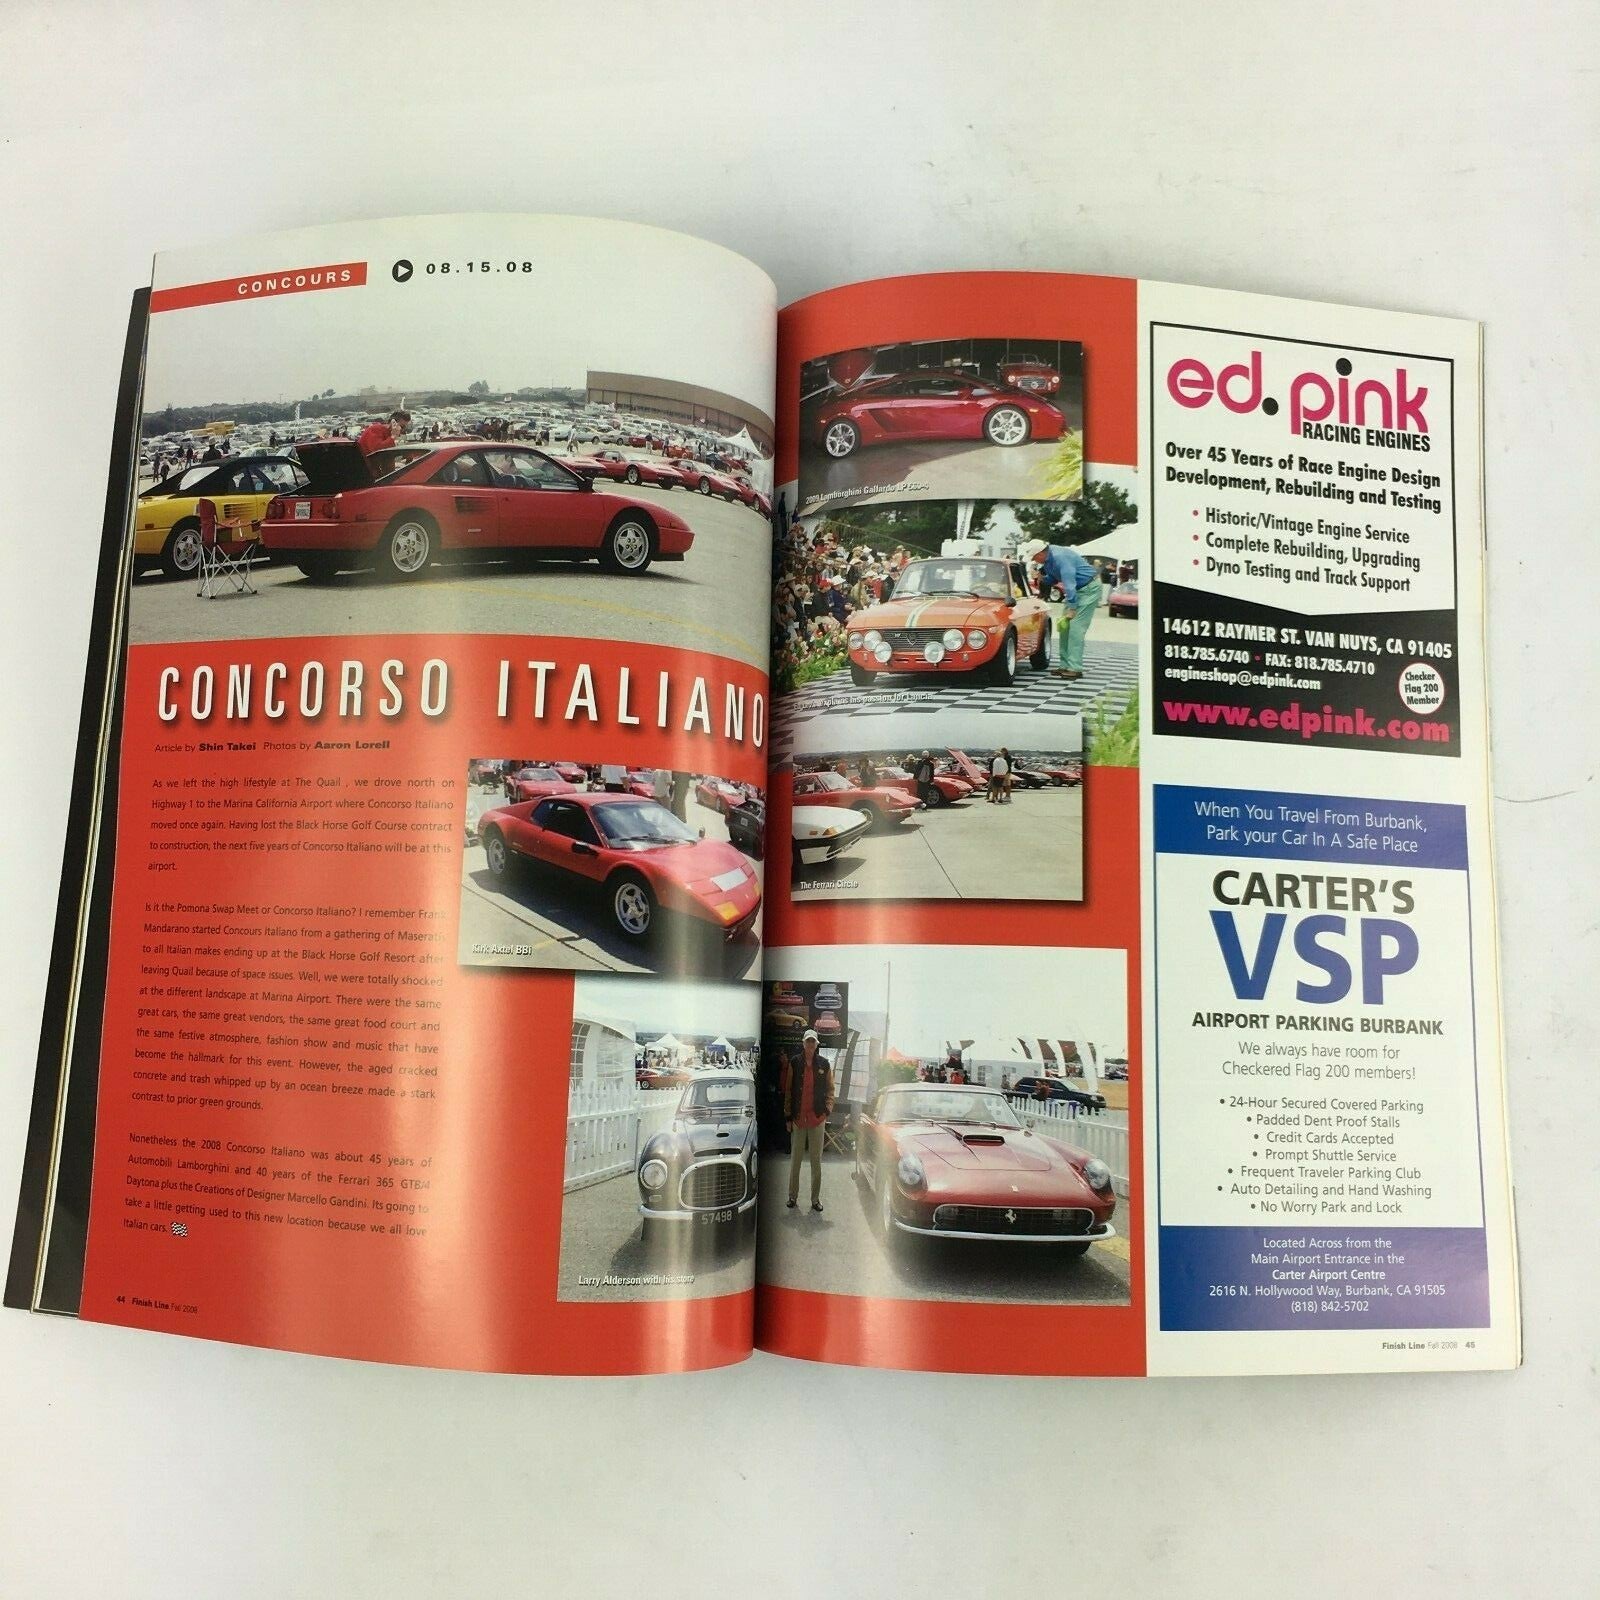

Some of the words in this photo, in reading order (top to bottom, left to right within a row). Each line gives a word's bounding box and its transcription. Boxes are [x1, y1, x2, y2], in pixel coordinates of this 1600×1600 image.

[426, 261, 534, 275] 08.15.08
[237, 268, 352, 295] CONCOURS
[1290, 357, 1429, 435] pink
[1302, 422, 1361, 444] RACING
[1365, 429, 1431, 452] ENGINES
[1165, 441, 1203, 460] Over
[1207, 446, 1227, 463] 45
[1230, 448, 1273, 468] Years
[1278, 454, 1294, 471] of
[1298, 456, 1333, 475] Race
[1337, 461, 1387, 482] Engine
[1391, 467, 1440, 490] Design
[1166, 466, 1271, 494] Development,
[1275, 478, 1354, 504] Rebuilding
[1358, 488, 1386, 505] and
[1390, 491, 1441, 514] Testing
[1205, 507, 1314, 536] Historic/Vintage
[1317, 519, 1362, 540] Engine
[1365, 524, 1410, 544] Service
[1205, 532, 1270, 553] Complete
[1273, 538, 1348, 565] Rebuilding,
[1352, 547, 1420, 572] Upgrading
[1162, 618, 1210, 637] 14612
[1214, 622, 1277, 642] RAYMER
[1280, 628, 1302, 645] ST.
[1304, 630, 1335, 648] VAN
[1339, 633, 1382, 655] NUYS,
[1385, 638, 1404, 654] CA
[1407, 640, 1453, 659] 91405
[1164, 645, 1250, 664] 818.785.6740
[1265, 652, 1292, 669] FAX:
[1294, 654, 1376, 675] 818.785.4710
[1164, 667, 1321, 689] engineshop@edpink.com
[1403, 671, 1436, 682] Checker
[1403, 683, 1422, 695] Flag
[1422, 683, 1440, 693] 200
[157, 657, 449, 723] CONCORSO
[497, 659, 765, 750] ITALIANO
[1405, 695, 1441, 706] Member
[1162, 700, 1451, 743] www.edpink.com
[154, 743, 183, 753] Article
[184, 744, 196, 753] by
[198, 742, 224, 752] Shin
[226, 742, 256, 751] Takei
[263, 741, 296, 752] Photos
[299, 742, 311, 752] by
[313, 741, 351, 750] Aaron
[355, 740, 390, 750] Lorell
[150, 819, 177, 831] moved
[179, 820, 199, 830] once
[201, 820, 227, 832] again.
[228, 820, 259, 833] Having
[260, 818, 276, 830] lost
[277, 819, 294, 830] the
[296, 819, 319, 830] Black
[322, 820, 349, 830] Horse
[351, 819, 373, 831] Golf
[374, 820, 408, 831] Course
[410, 821, 453, 832] contract
[1194, 801, 1240, 818] When
[1244, 804, 1273, 821] You
[1277, 806, 1319, 824] Travel
[1324, 809, 1360, 826] From
[1365, 812, 1427, 832] Burbank,
[147, 861, 178, 872] airport.
[800, 881, 812, 890] The
[1212, 869, 1415, 914] CARTER'S
[1208, 910, 1420, 1006] VSP
[1191, 1012, 1270, 1029] AIRPORT
[1275, 1015, 1354, 1032] PARKING
[1360, 1018, 1444, 1035] BURBANK
[134, 1048, 168, 1060] become
[170, 1051, 184, 1061] the
[187, 1051, 225, 1064] hallmark
[229, 1053, 243, 1065] for
[246, 1055, 264, 1066] this
[266, 1056, 296, 1068] event.
[300, 1059, 341, 1073] However,
[345, 1061, 364, 1073] the
[368, 1064, 393, 1076] aged
[398, 1065, 438, 1077] cracked
[1222, 1060, 1291, 1077] Checkered
[1295, 1063, 1321, 1081] Flag
[1325, 1064, 1350, 1078] 200
[1354, 1066, 1415, 1080] members!
[1229, 1096, 1278, 1108] 24-Hour
[1281, 1097, 1327, 1110] Secured
[1330, 1098, 1377, 1111] Covered
[1380, 1099, 1424, 1115] Parking
[127, 1154, 173, 1169] Automobili
[176, 1159, 230, 1175] Lamborghini
[234, 1165, 252, 1176] and
[255, 1166, 270, 1177] 40
[272, 1168, 296, 1181] years
[300, 1170, 312, 1181] of
[316, 1171, 333, 1183] the
[338, 1173, 370, 1186] Ferrari
[376, 1177, 394, 1188] 365
[1241, 1165, 1295, 1180] Frequent
[1297, 1166, 1345, 1178] Traveler
[1348, 1166, 1392, 1182] Parking
[1395, 1167, 1421, 1179] Club
[123, 1218, 149, 1230] Italian
[149, 1220, 170, 1234] cars.
[1263, 1237, 1306, 1249] Located
[1308, 1238, 1343, 1249] Across
[1344, 1236, 1371, 1249] from
[1373, 1237, 1392, 1249] the
[578, 1275, 601, 1288] Larry
[1272, 1269, 1306, 1280] Carter
[1308, 1269, 1348, 1282] Airport
[1350, 1269, 1386, 1280] Centre
[1209, 1285, 1236, 1297] 2616
[1239, 1285, 1251, 1296] N.
[1255, 1284, 1314, 1299] Hollywood
[1315, 1285, 1342, 1299] Way,
[1345, 1284, 1393, 1296] Burbank,
[1396, 1284, 1412, 1296] CA
[1414, 1284, 1446, 1296] 91505
[1290, 1300, 1318, 1314] (818)
[1320, 1300, 1369, 1312] 842-5702
